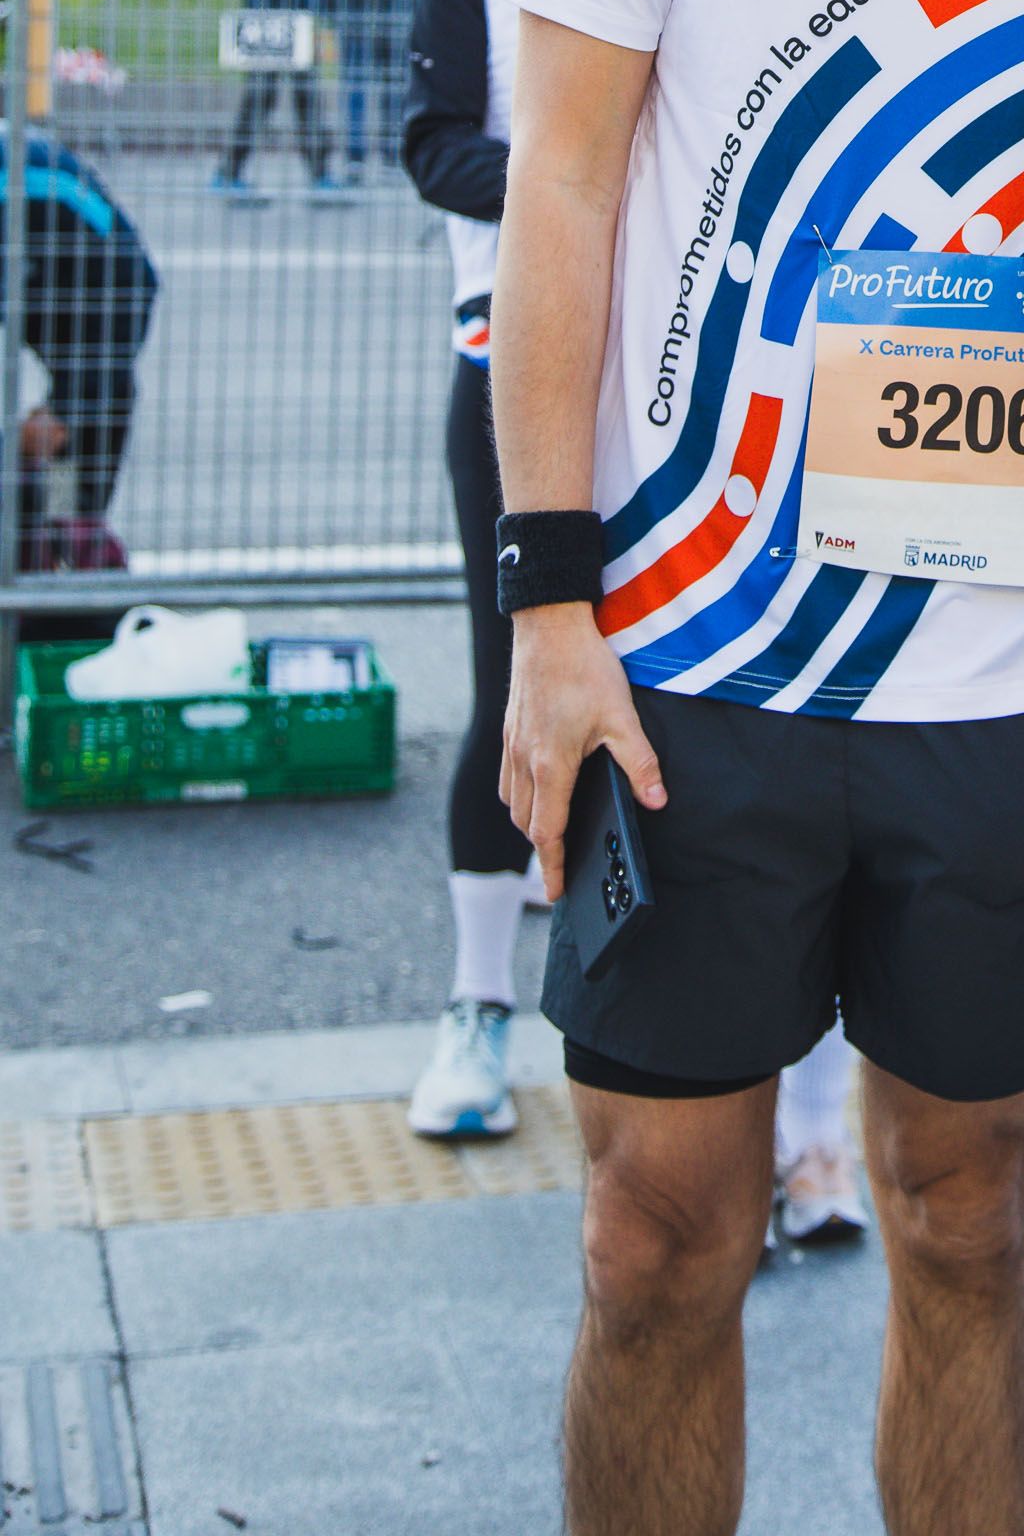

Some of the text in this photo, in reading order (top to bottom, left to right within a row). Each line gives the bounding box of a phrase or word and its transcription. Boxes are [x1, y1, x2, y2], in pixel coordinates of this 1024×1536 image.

[647, 132, 743, 427] Comprometidos
[737, 68, 782, 131] con
[769, 36, 812, 70] la
[828, 263, 994, 302] ProFuturo
[859, 338, 873, 355] X
[879, 339, 954, 360] Carrera
[824, 536, 856, 550] ADM
[923, 551, 988, 571] MADRID
